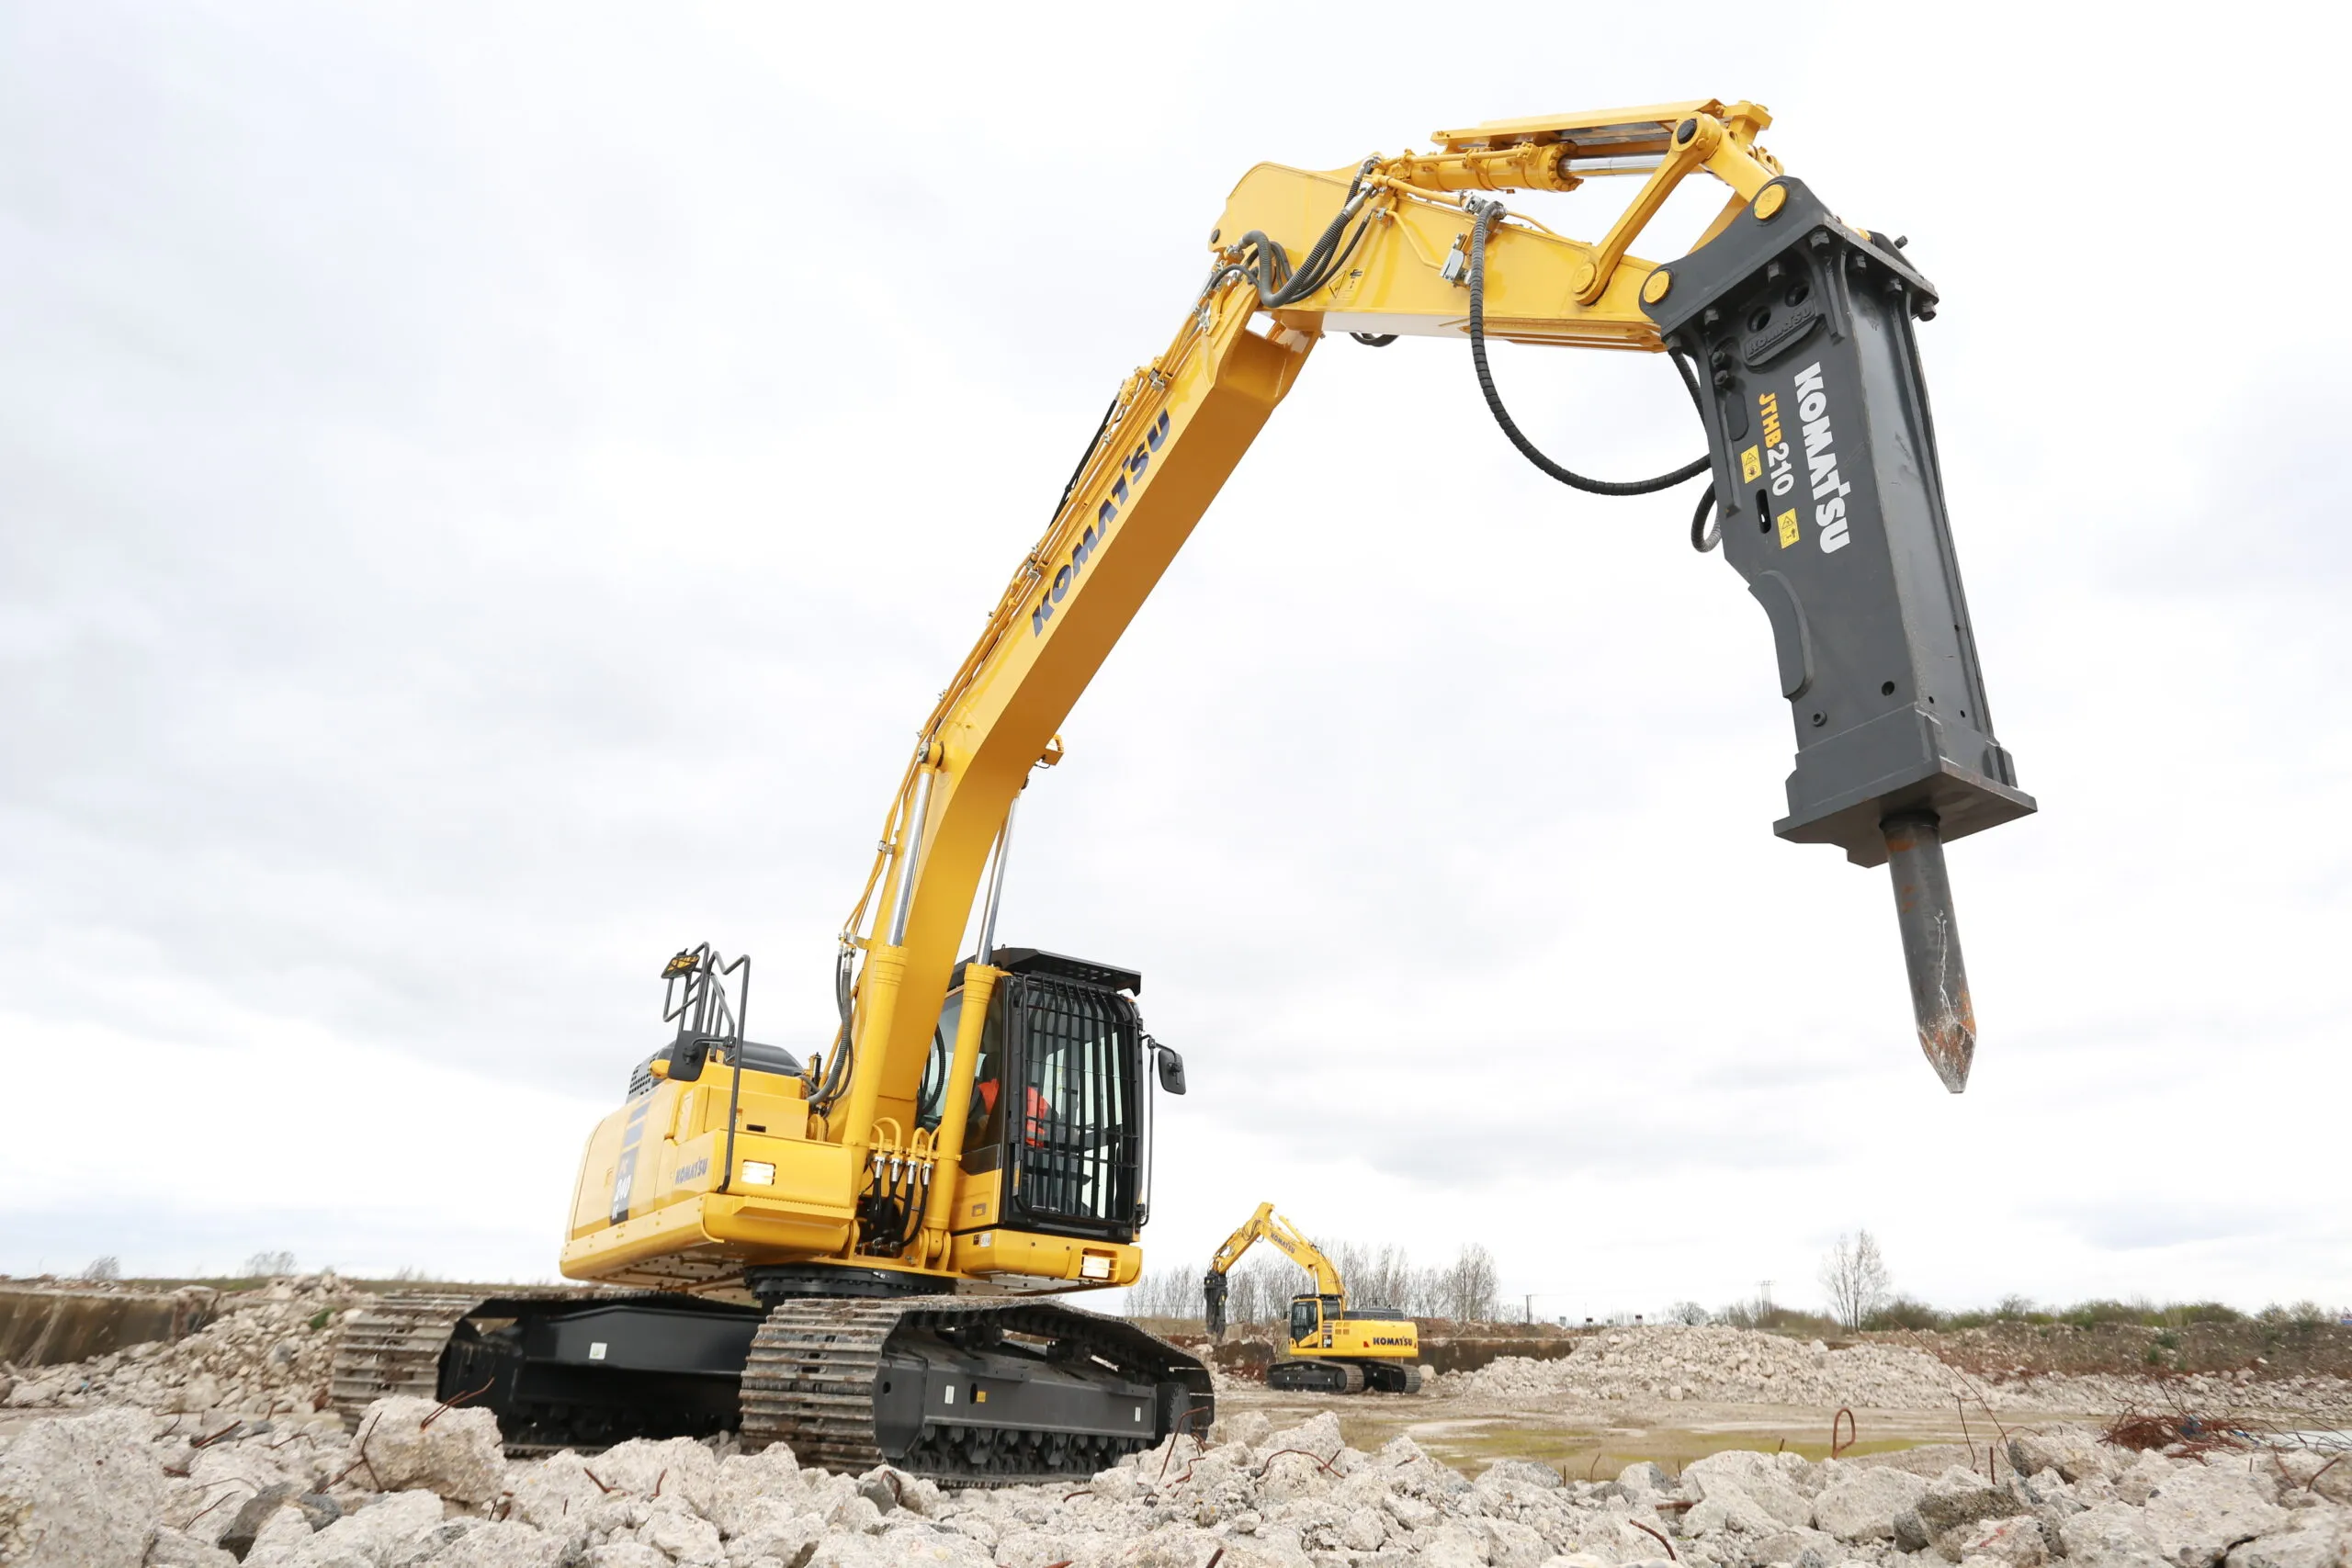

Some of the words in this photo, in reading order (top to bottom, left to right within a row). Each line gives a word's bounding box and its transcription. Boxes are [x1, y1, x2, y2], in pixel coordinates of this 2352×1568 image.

[1758, 392, 1794, 496] JTHB210
[1794, 361, 1851, 554] KOMATSU
[1032, 407, 1170, 637] KOMATSU
[675, 1156, 708, 1184] KOMATSU
[1271, 1232, 1295, 1254] KOMATSU
[1373, 1336, 1413, 1347] KOMATSU
